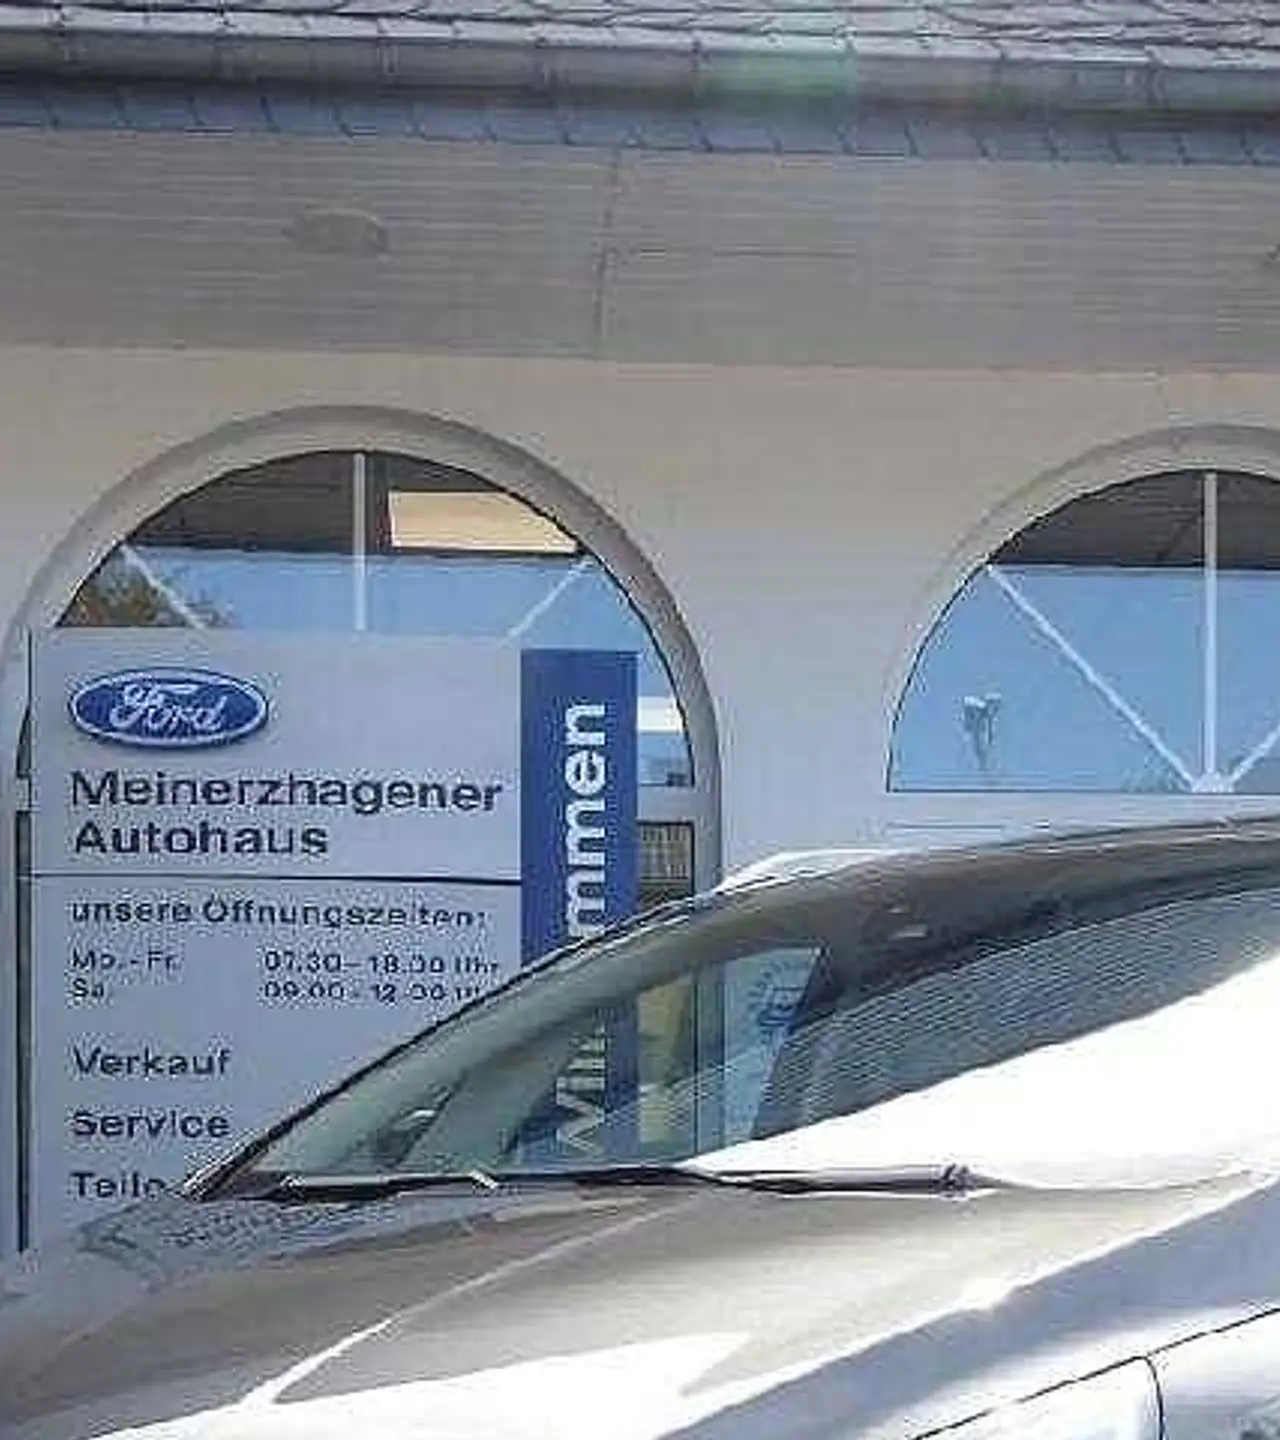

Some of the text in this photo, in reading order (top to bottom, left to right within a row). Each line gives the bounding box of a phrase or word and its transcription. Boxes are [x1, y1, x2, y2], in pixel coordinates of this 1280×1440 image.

[109, 682, 228, 732] Ford
[71, 771, 502, 814] Meinerzhagener
[74, 820, 328, 854] Autohaus
[72, 902, 191, 922] unsere
[74, 1047, 231, 1076] Verkauf
[72, 1110, 230, 1139] Service
